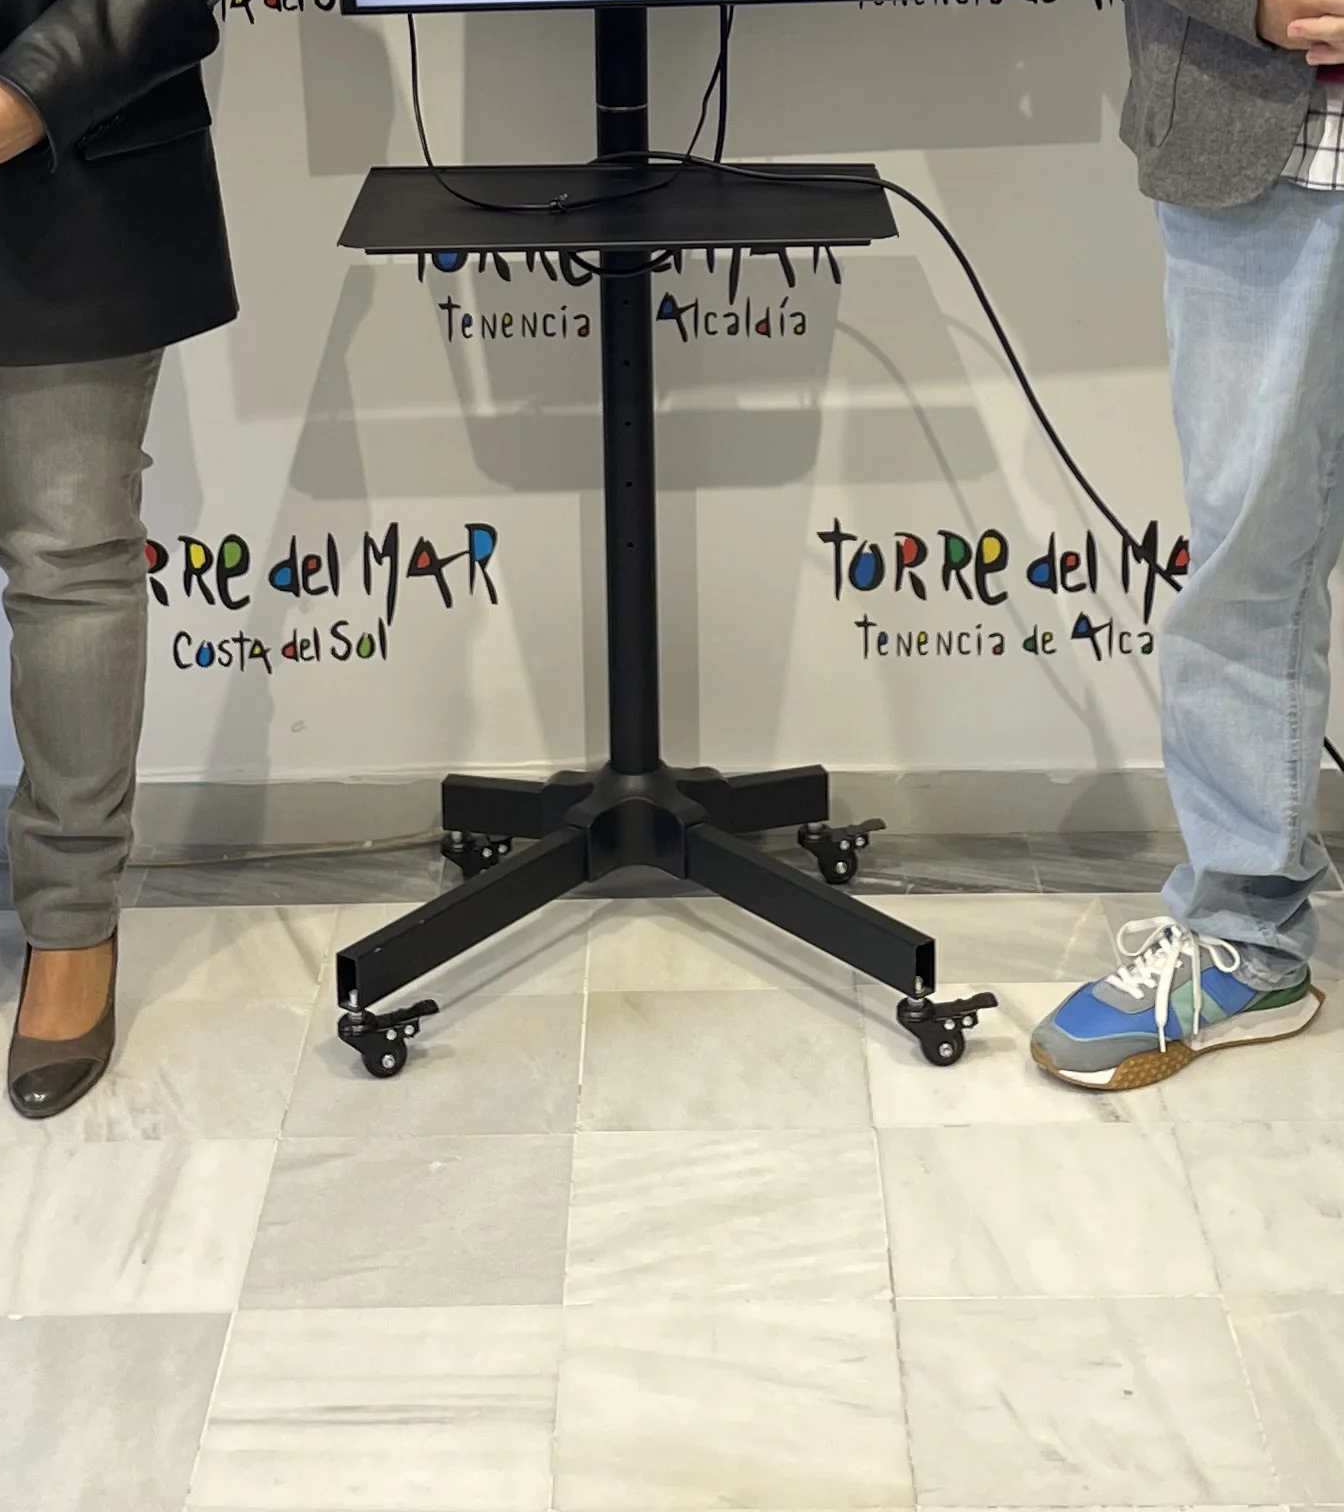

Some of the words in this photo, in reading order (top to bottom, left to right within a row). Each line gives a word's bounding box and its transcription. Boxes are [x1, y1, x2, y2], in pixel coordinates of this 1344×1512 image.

[269, 533, 339, 597] del
[364, 523, 497, 626] MAR
[1027, 530, 1097, 594] del
[282, 628, 320, 661] del
[331, 618, 386, 661] Sol
[1023, 625, 1056, 655] de
